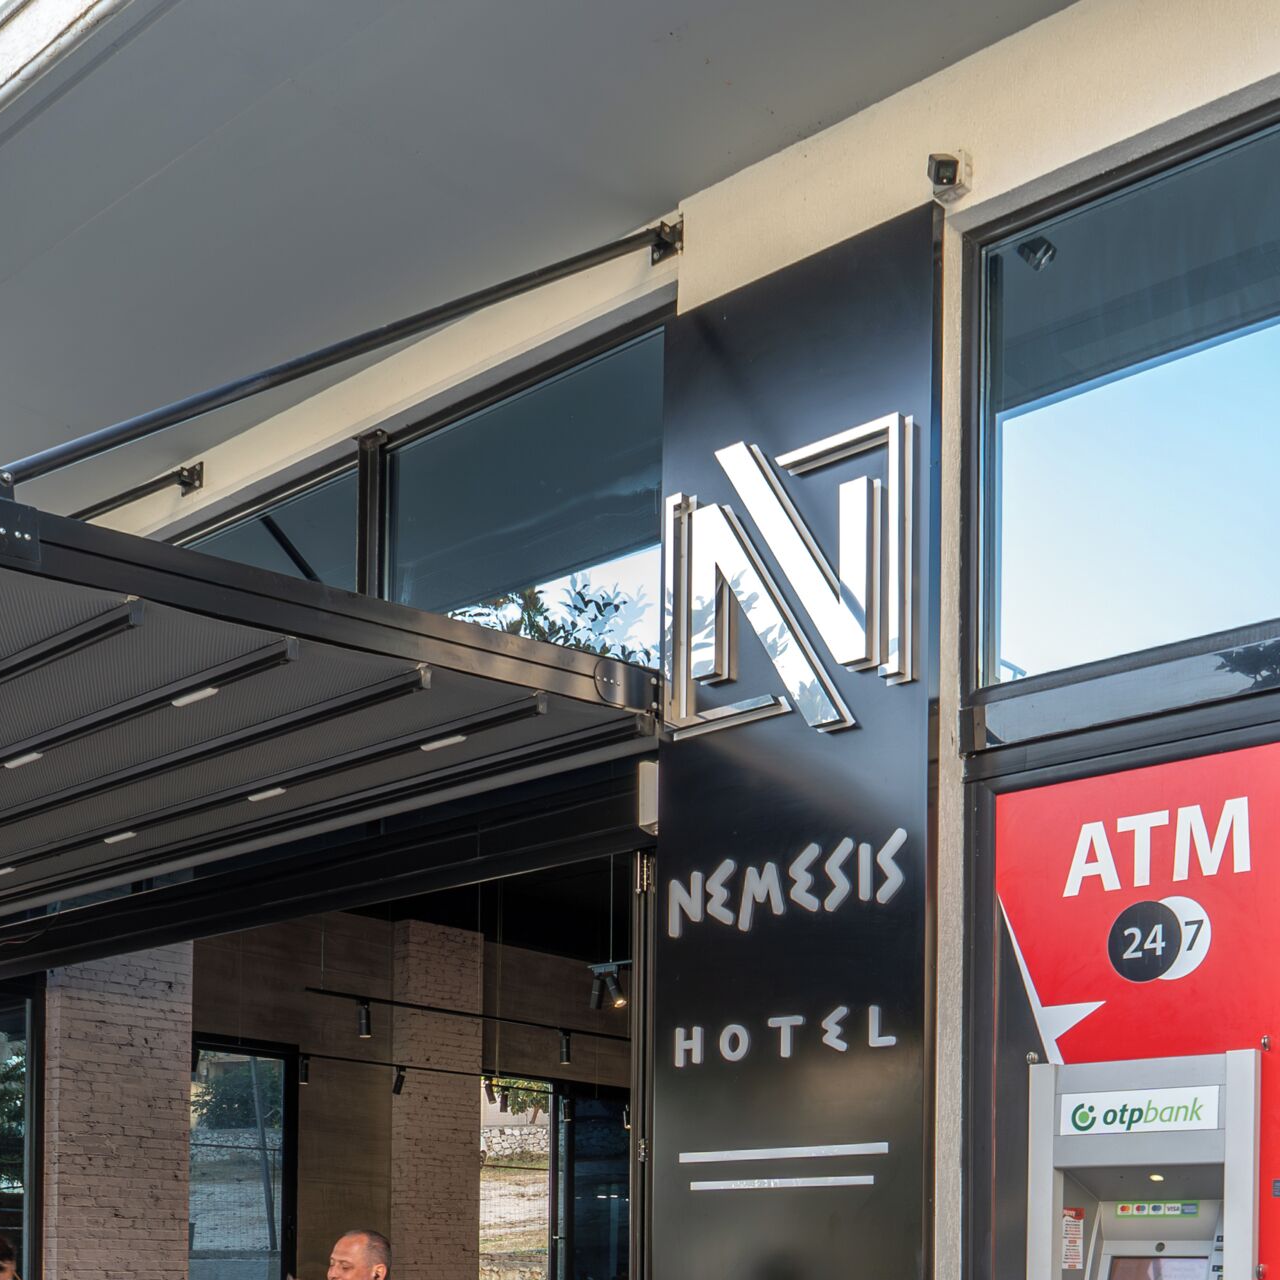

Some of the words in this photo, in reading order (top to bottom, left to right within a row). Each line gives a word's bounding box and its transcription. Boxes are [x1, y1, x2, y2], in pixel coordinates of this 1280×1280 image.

[1062, 796, 1251, 898] ATM
[668, 827, 908, 938] NEMESIS
[1122, 924, 1166, 960] 24
[1184, 919, 1204, 952] 7
[674, 1004, 897, 1068] HOTEL
[1103, 1097, 1204, 1131] otpbank
